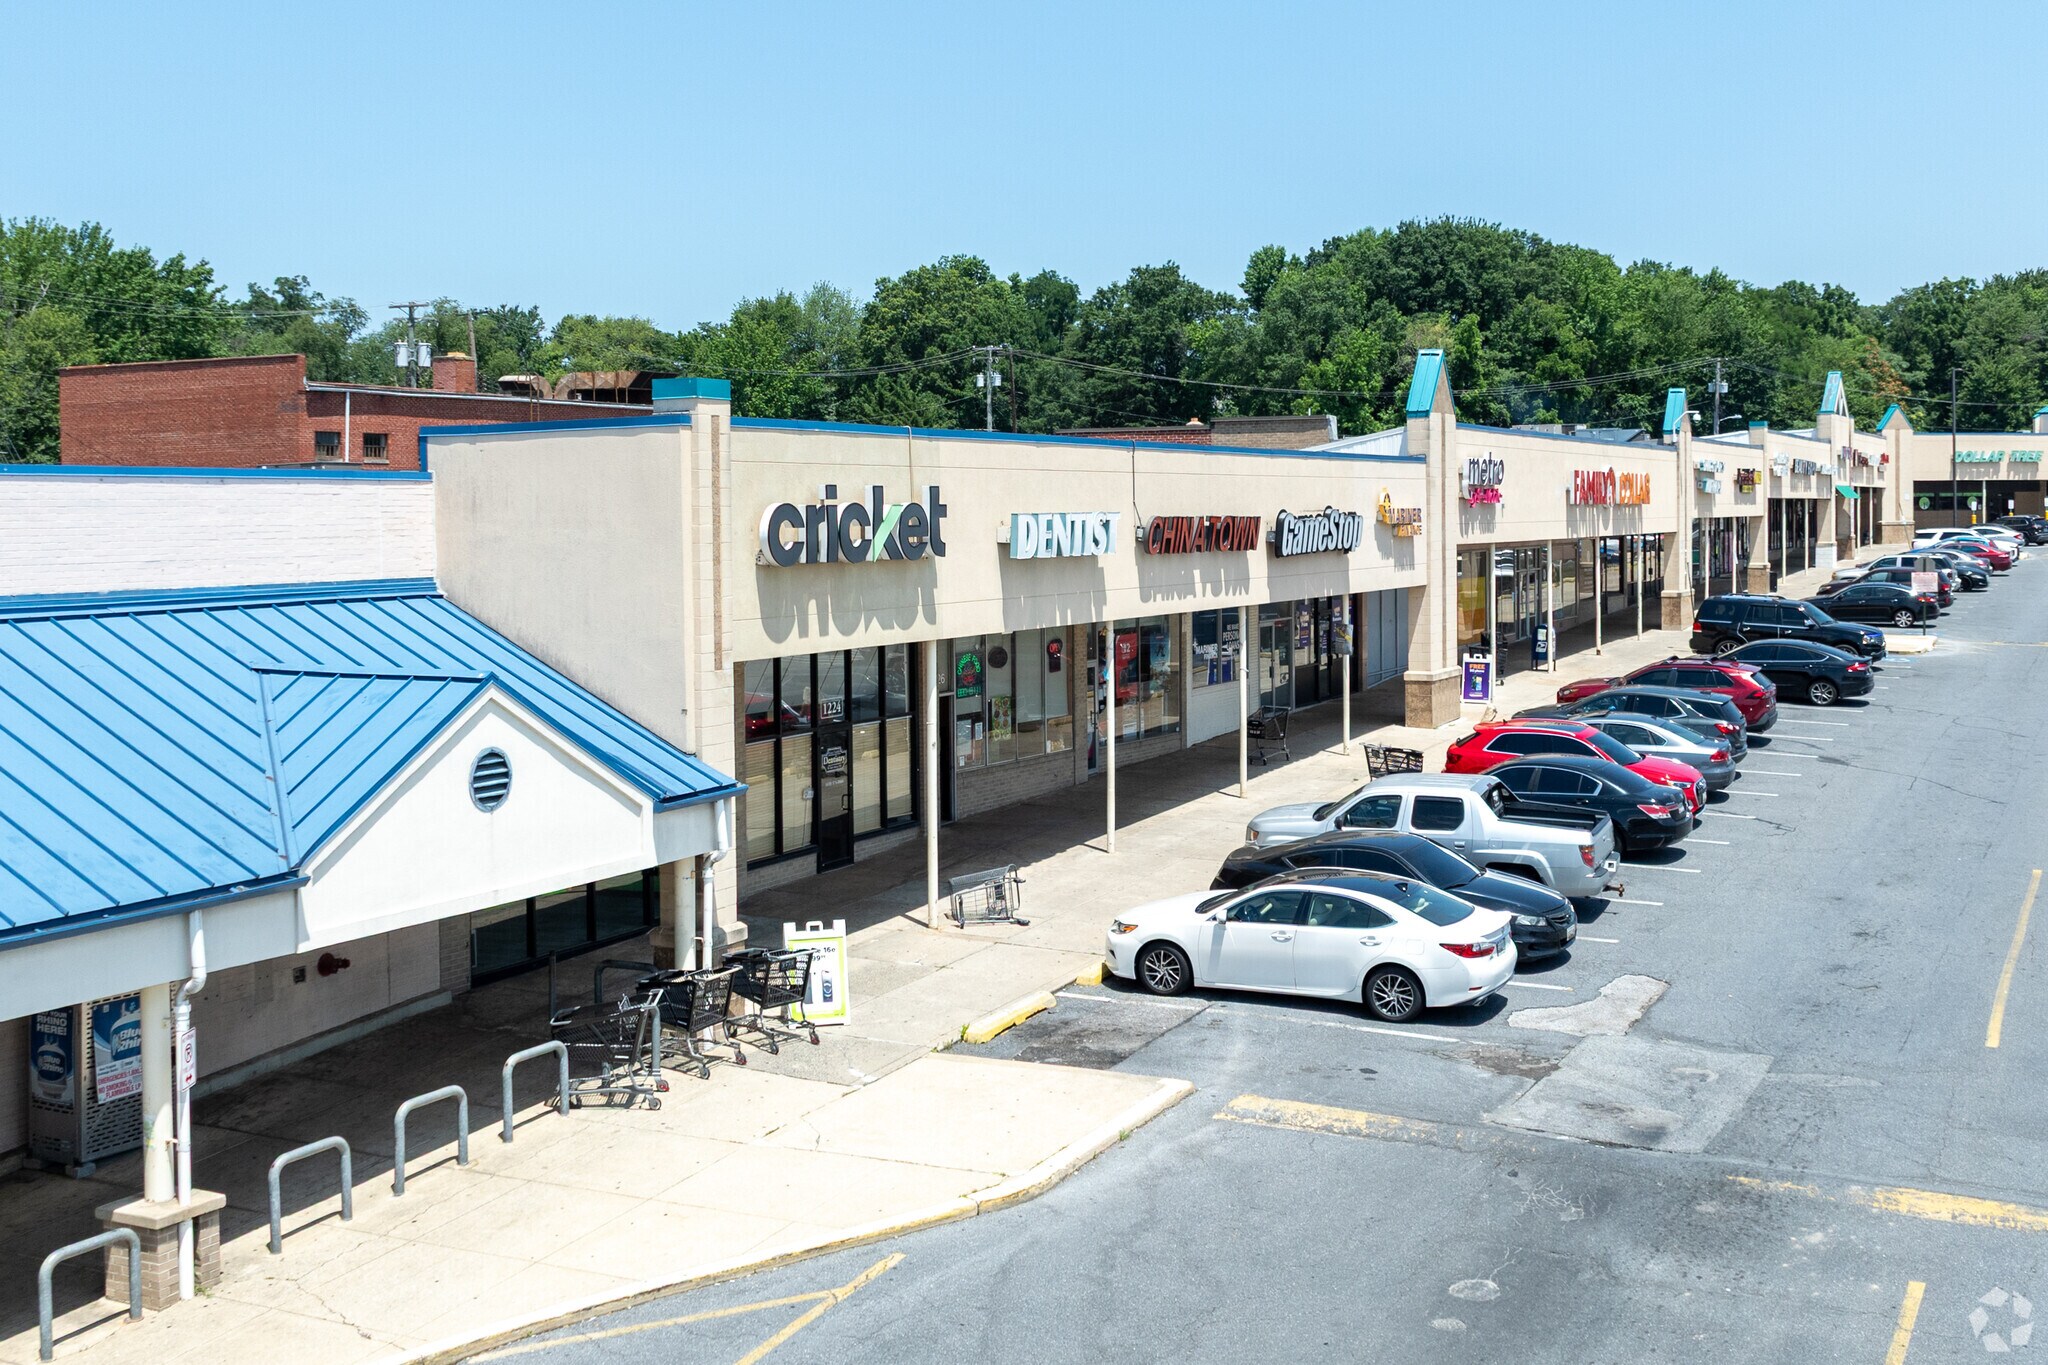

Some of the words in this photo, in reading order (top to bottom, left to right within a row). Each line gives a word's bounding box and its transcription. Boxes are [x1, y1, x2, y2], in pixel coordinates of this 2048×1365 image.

[1468, 451, 1504, 485] metro
[1955, 450, 2005, 463] DOLLAR
[2009, 450, 2044, 462] TREE
[1574, 470, 1610, 505] FAMILY
[1619, 471, 1651, 505] DOLLAR
[763, 484, 947, 567] cricket
[1387, 507, 1422, 523] MARINER
[1014, 512, 1120, 559] DENTIST
[1279, 507, 1363, 557] GameStop
[823, 700, 841, 715] 1224
[36, 1014, 68, 1027] RHINO
[36, 1022, 68, 1036] HERE!
